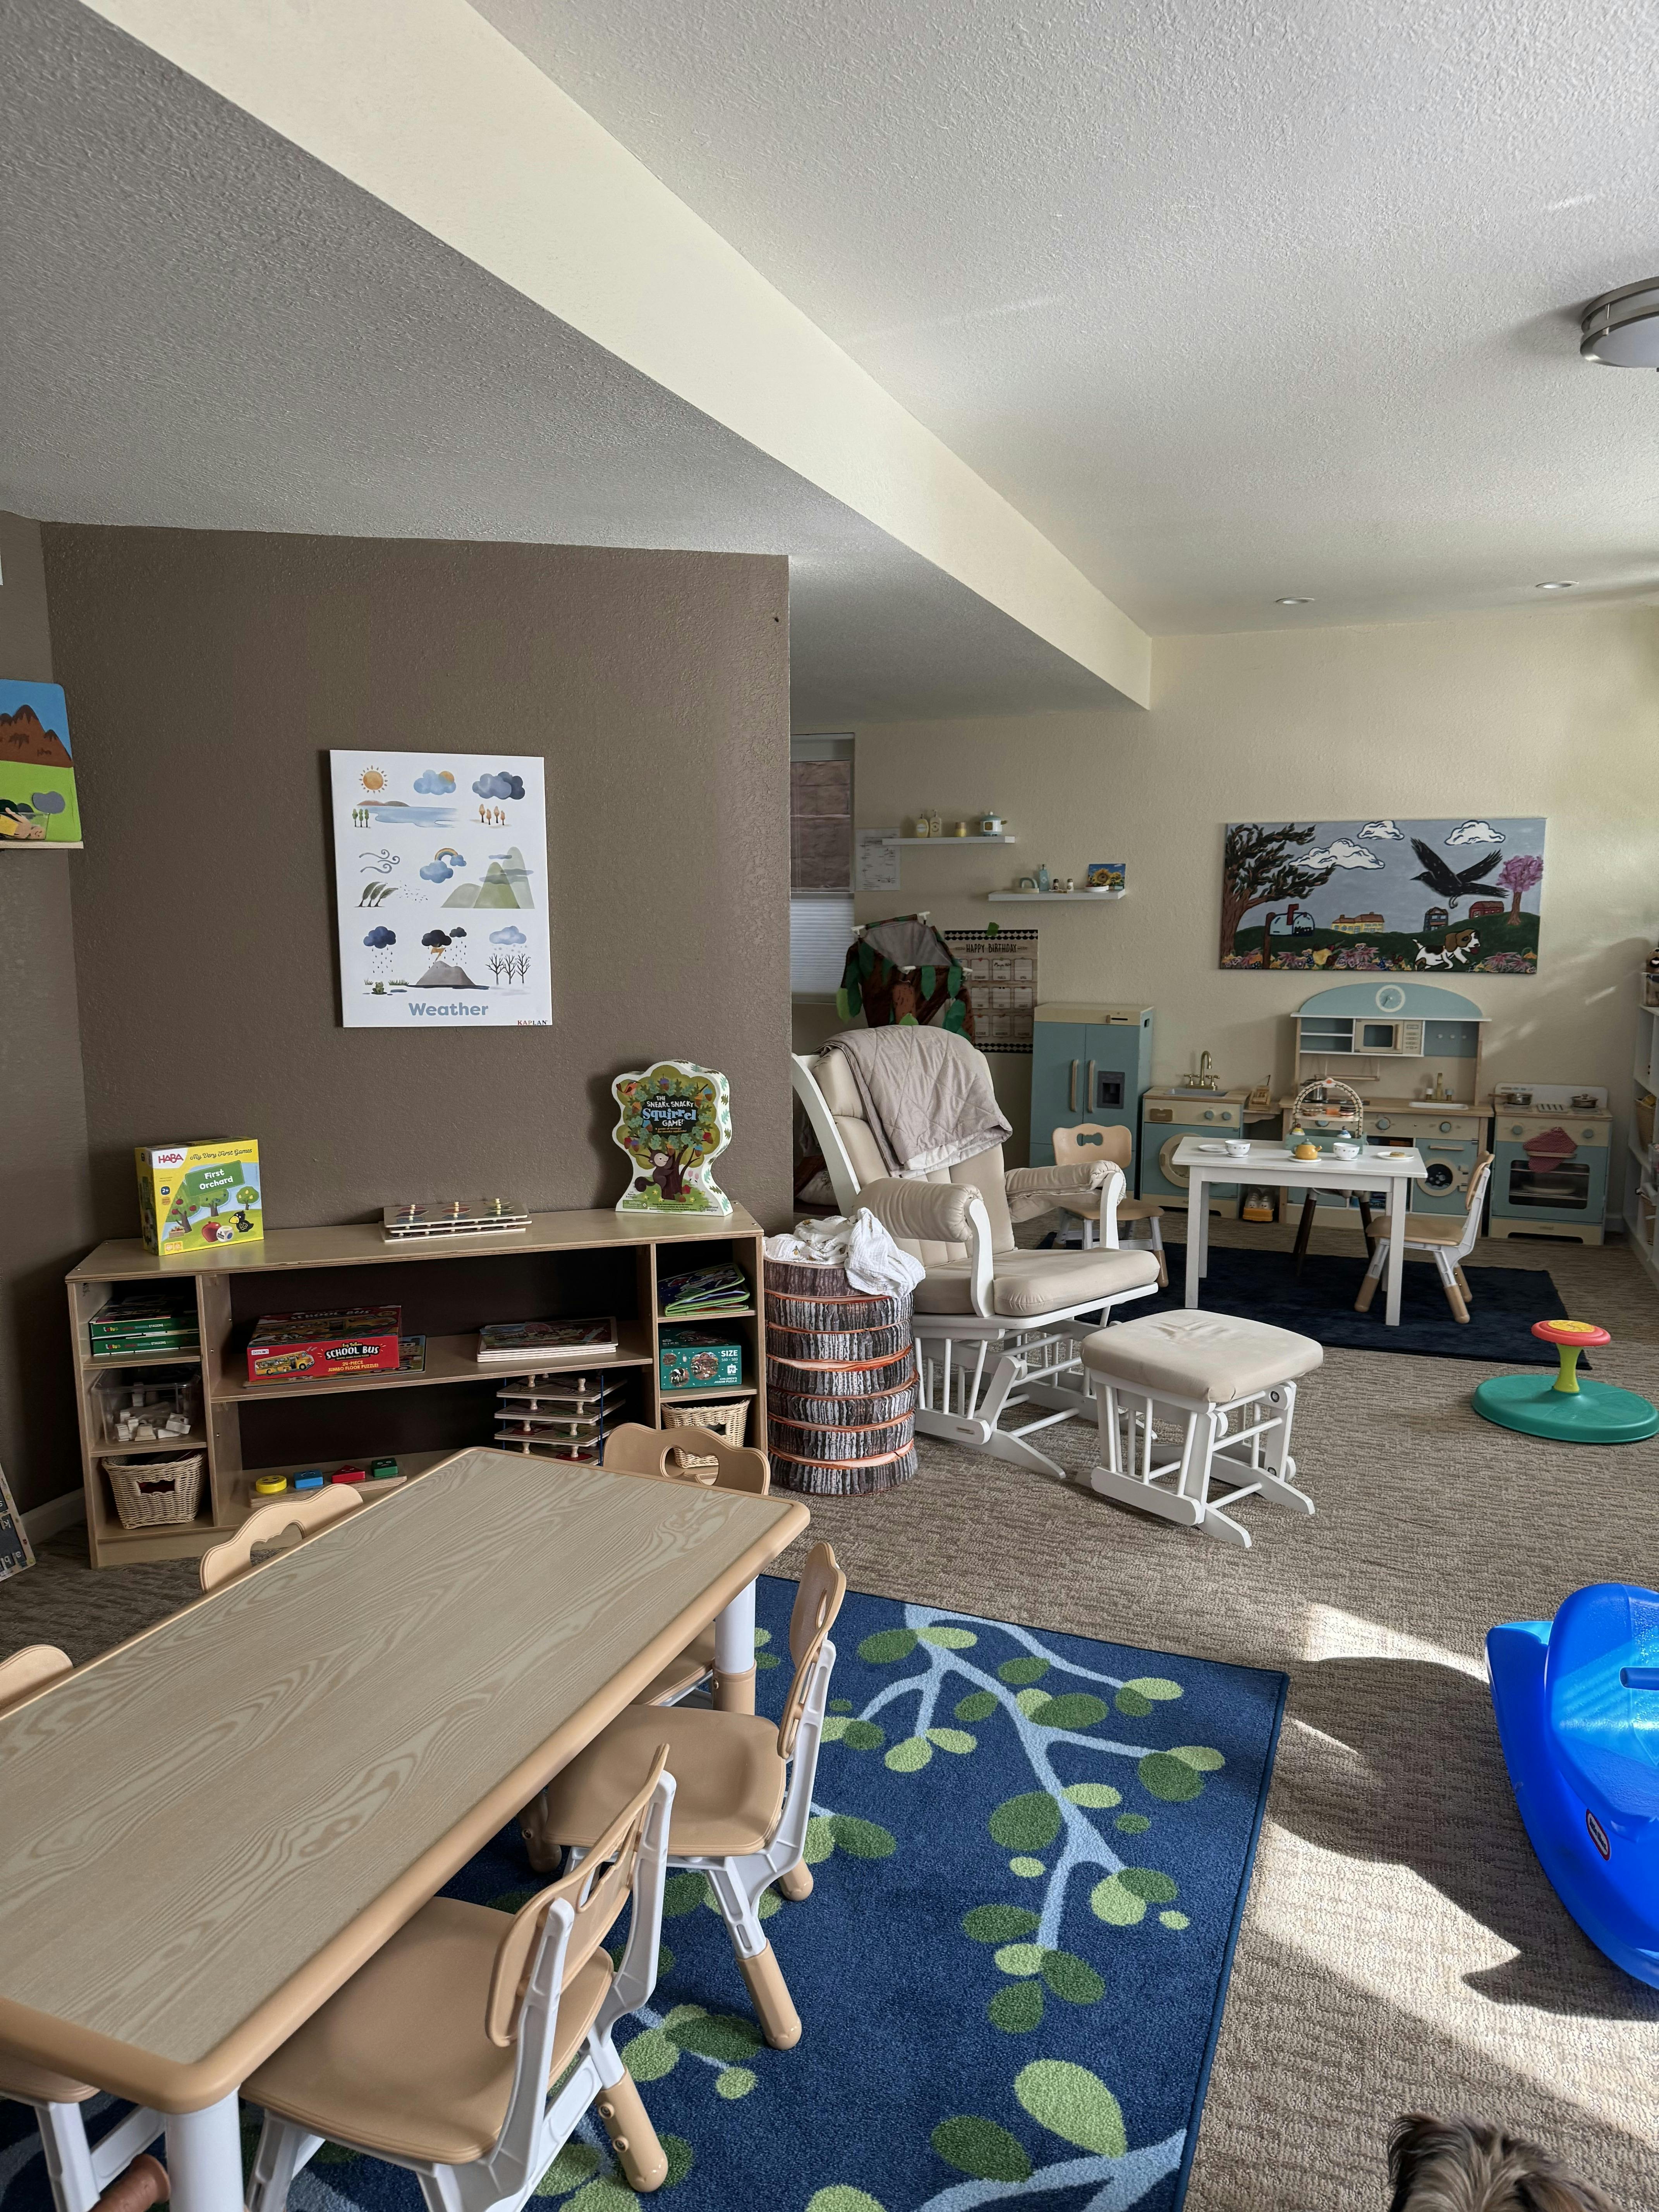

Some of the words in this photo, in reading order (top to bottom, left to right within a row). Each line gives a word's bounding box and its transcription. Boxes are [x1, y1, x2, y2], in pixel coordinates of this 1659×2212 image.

[966, 944, 984, 953] HAPPY
[988, 943, 1017, 953] BIRTHDAY
[409, 1002, 489, 1016] Weather
[642, 1108, 696, 1121] Squirrel
[158, 1153, 184, 1163] HABA
[204, 1169, 225, 1179] First
[199, 1176, 234, 1190] Orchard
[326, 1346, 359, 1359] SCHOOL
[362, 1346, 379, 1354] BUS
